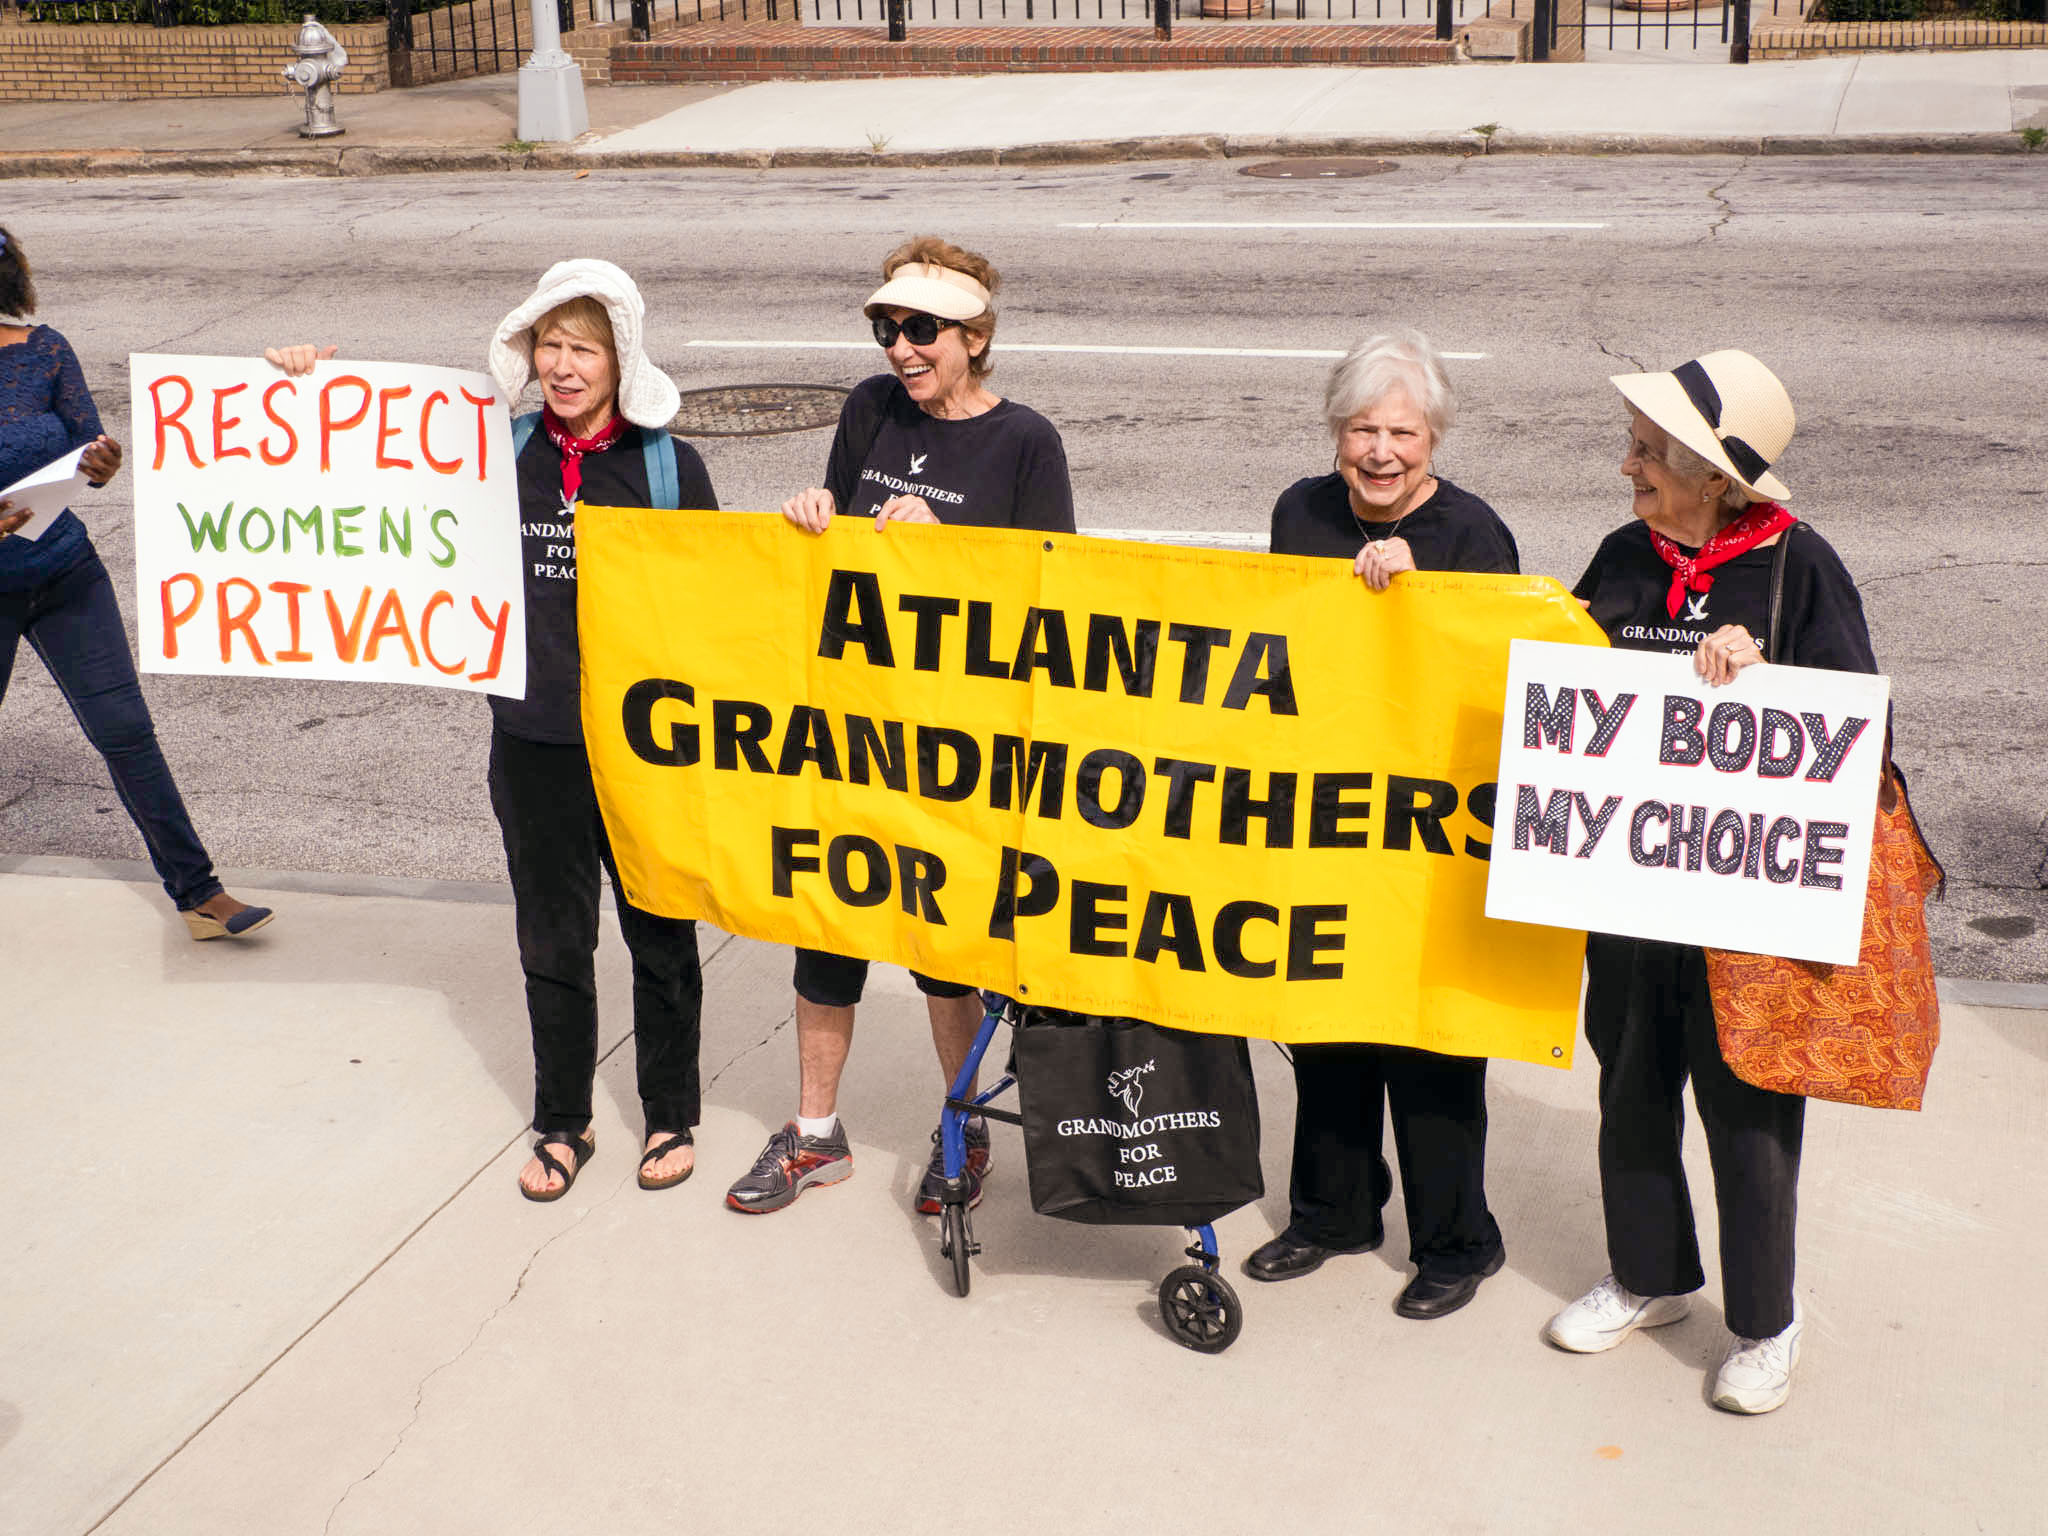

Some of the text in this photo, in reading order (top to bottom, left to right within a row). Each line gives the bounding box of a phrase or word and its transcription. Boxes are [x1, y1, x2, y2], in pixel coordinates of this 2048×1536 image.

[148, 374, 495, 481] RESPECT
[177, 501, 459, 568] WOMEN'S
[160, 572, 511, 683] PRIVACY
[817, 568, 1300, 717] ATLANTA
[1622, 625, 1764, 651] GRANDMOS
[621, 678, 1499, 862] GRANDMOTHERS
[1523, 682, 1871, 783] MY BODY
[1512, 784, 1850, 891] MY CHOICE
[771, 825, 1348, 981] FOR PEACE
[1057, 1111, 1221, 1139] GRANDMOTHERS
[1114, 1166, 1177, 1188] PEACE
[1120, 1143, 1163, 1164] FOR
